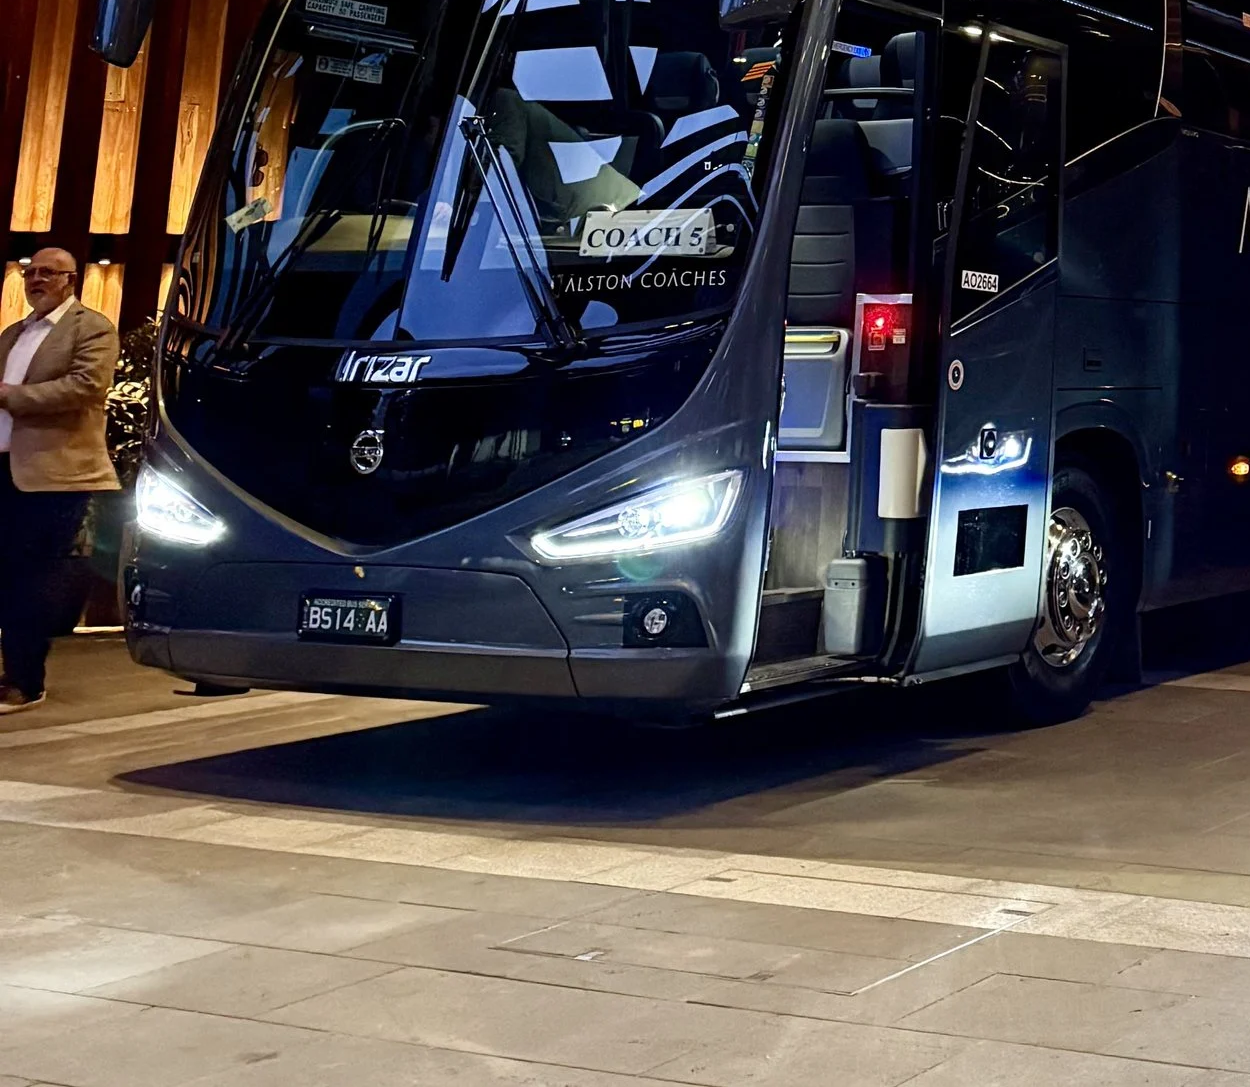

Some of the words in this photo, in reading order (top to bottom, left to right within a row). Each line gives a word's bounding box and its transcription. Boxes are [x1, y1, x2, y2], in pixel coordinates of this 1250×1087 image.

[587, 227, 681, 248] COACH
[689, 227, 703, 247] 5
[565, 273, 632, 293] ALSTON
[640, 268, 726, 288] COACHES
[309, 607, 355, 631] BS14
[365, 610, 388, 633] AA
